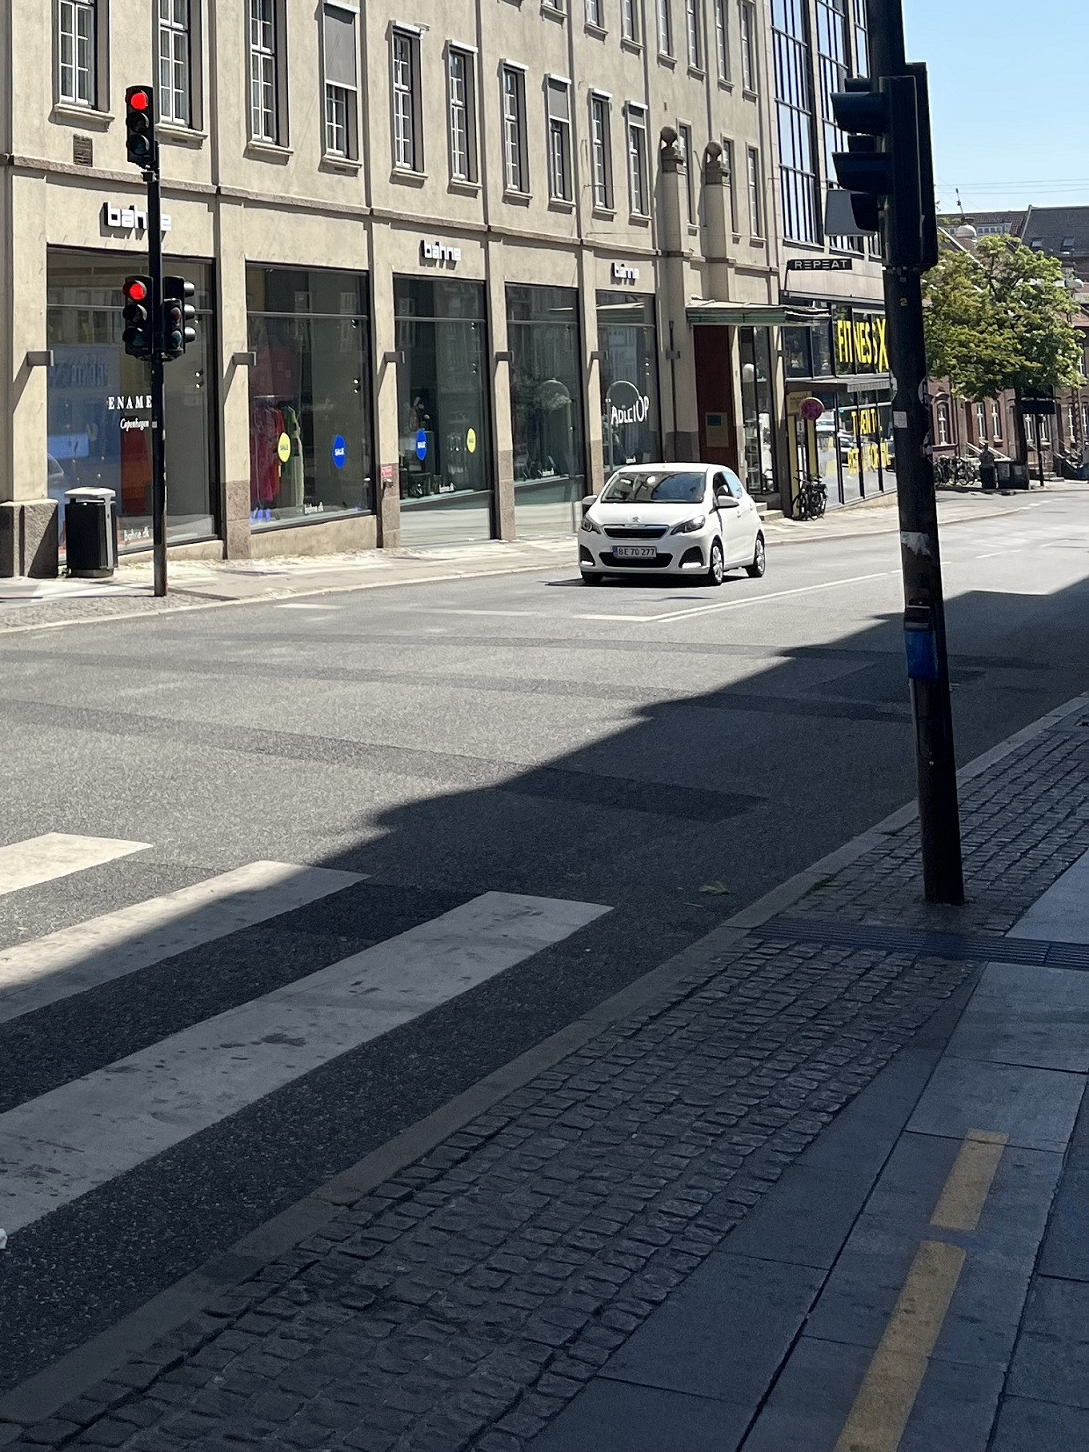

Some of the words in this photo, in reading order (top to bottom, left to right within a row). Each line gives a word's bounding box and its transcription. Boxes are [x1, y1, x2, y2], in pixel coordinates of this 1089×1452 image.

[105, 201, 172, 232] bahe
[422, 239, 462, 261] bahne
[794, 260, 847, 269] REPEAT
[120, 417, 150, 432] Copenhagen
[641, 548, 655, 556] 277
